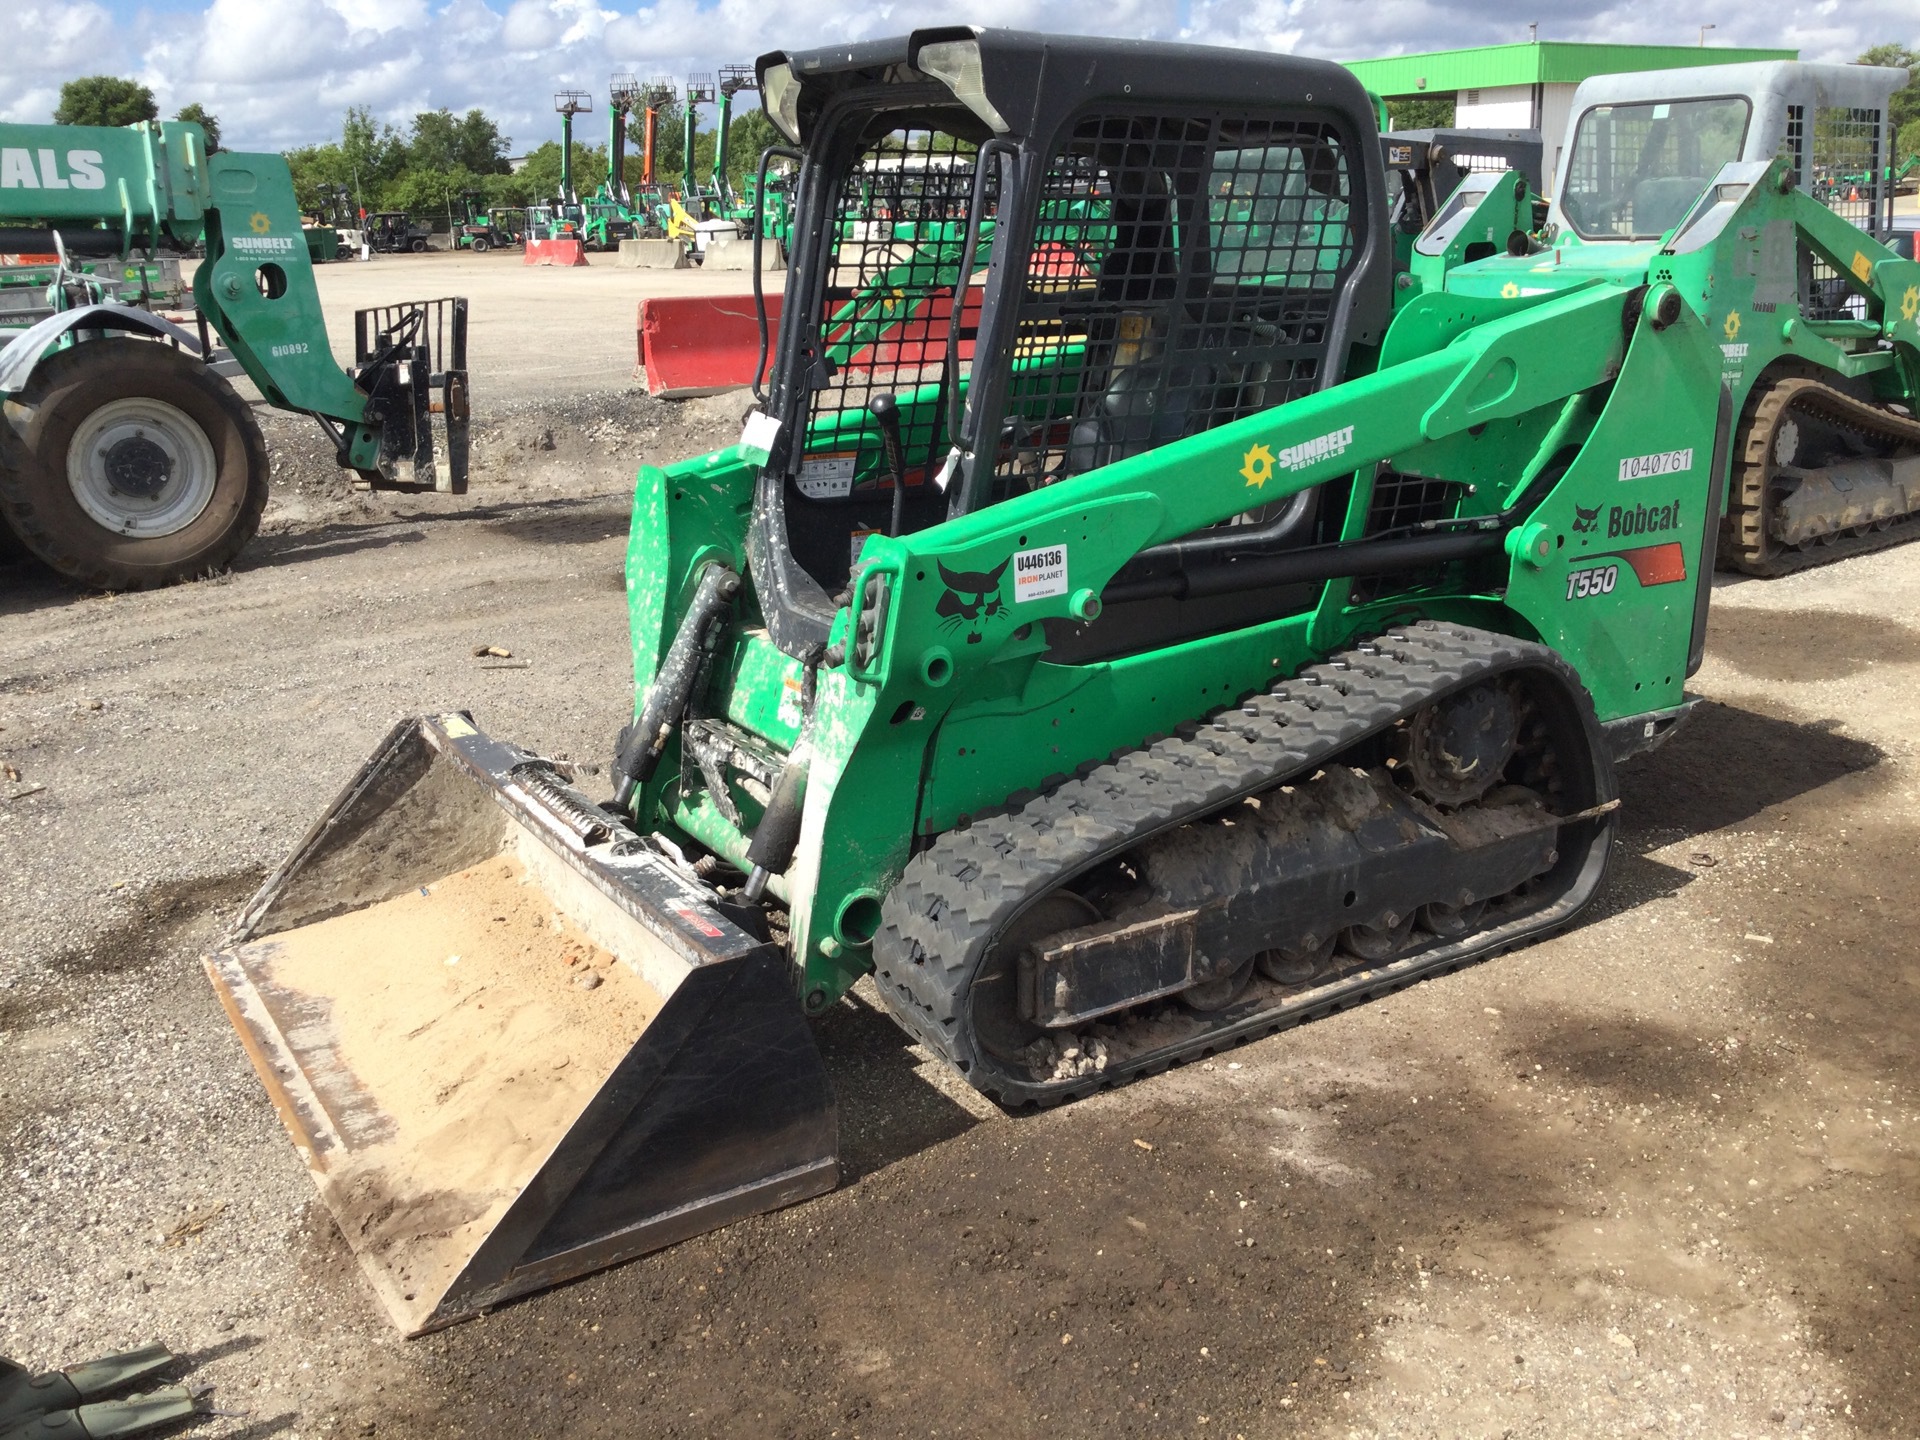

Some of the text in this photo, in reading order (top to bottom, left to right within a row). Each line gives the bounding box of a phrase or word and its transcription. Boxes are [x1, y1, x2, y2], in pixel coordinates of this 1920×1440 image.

[0, 147, 106, 190] ALS
[232, 237, 293, 249] SUNBELT
[272, 342, 309, 357] 610892
[1278, 424, 1355, 468] SUNBELT
[1290, 446, 1345, 472] RENTALS
[1621, 450, 1690, 479] 1040761
[1607, 499, 1680, 539] Bobcat
[1018, 550, 1062, 572] U446136
[1566, 564, 1618, 601] T550
